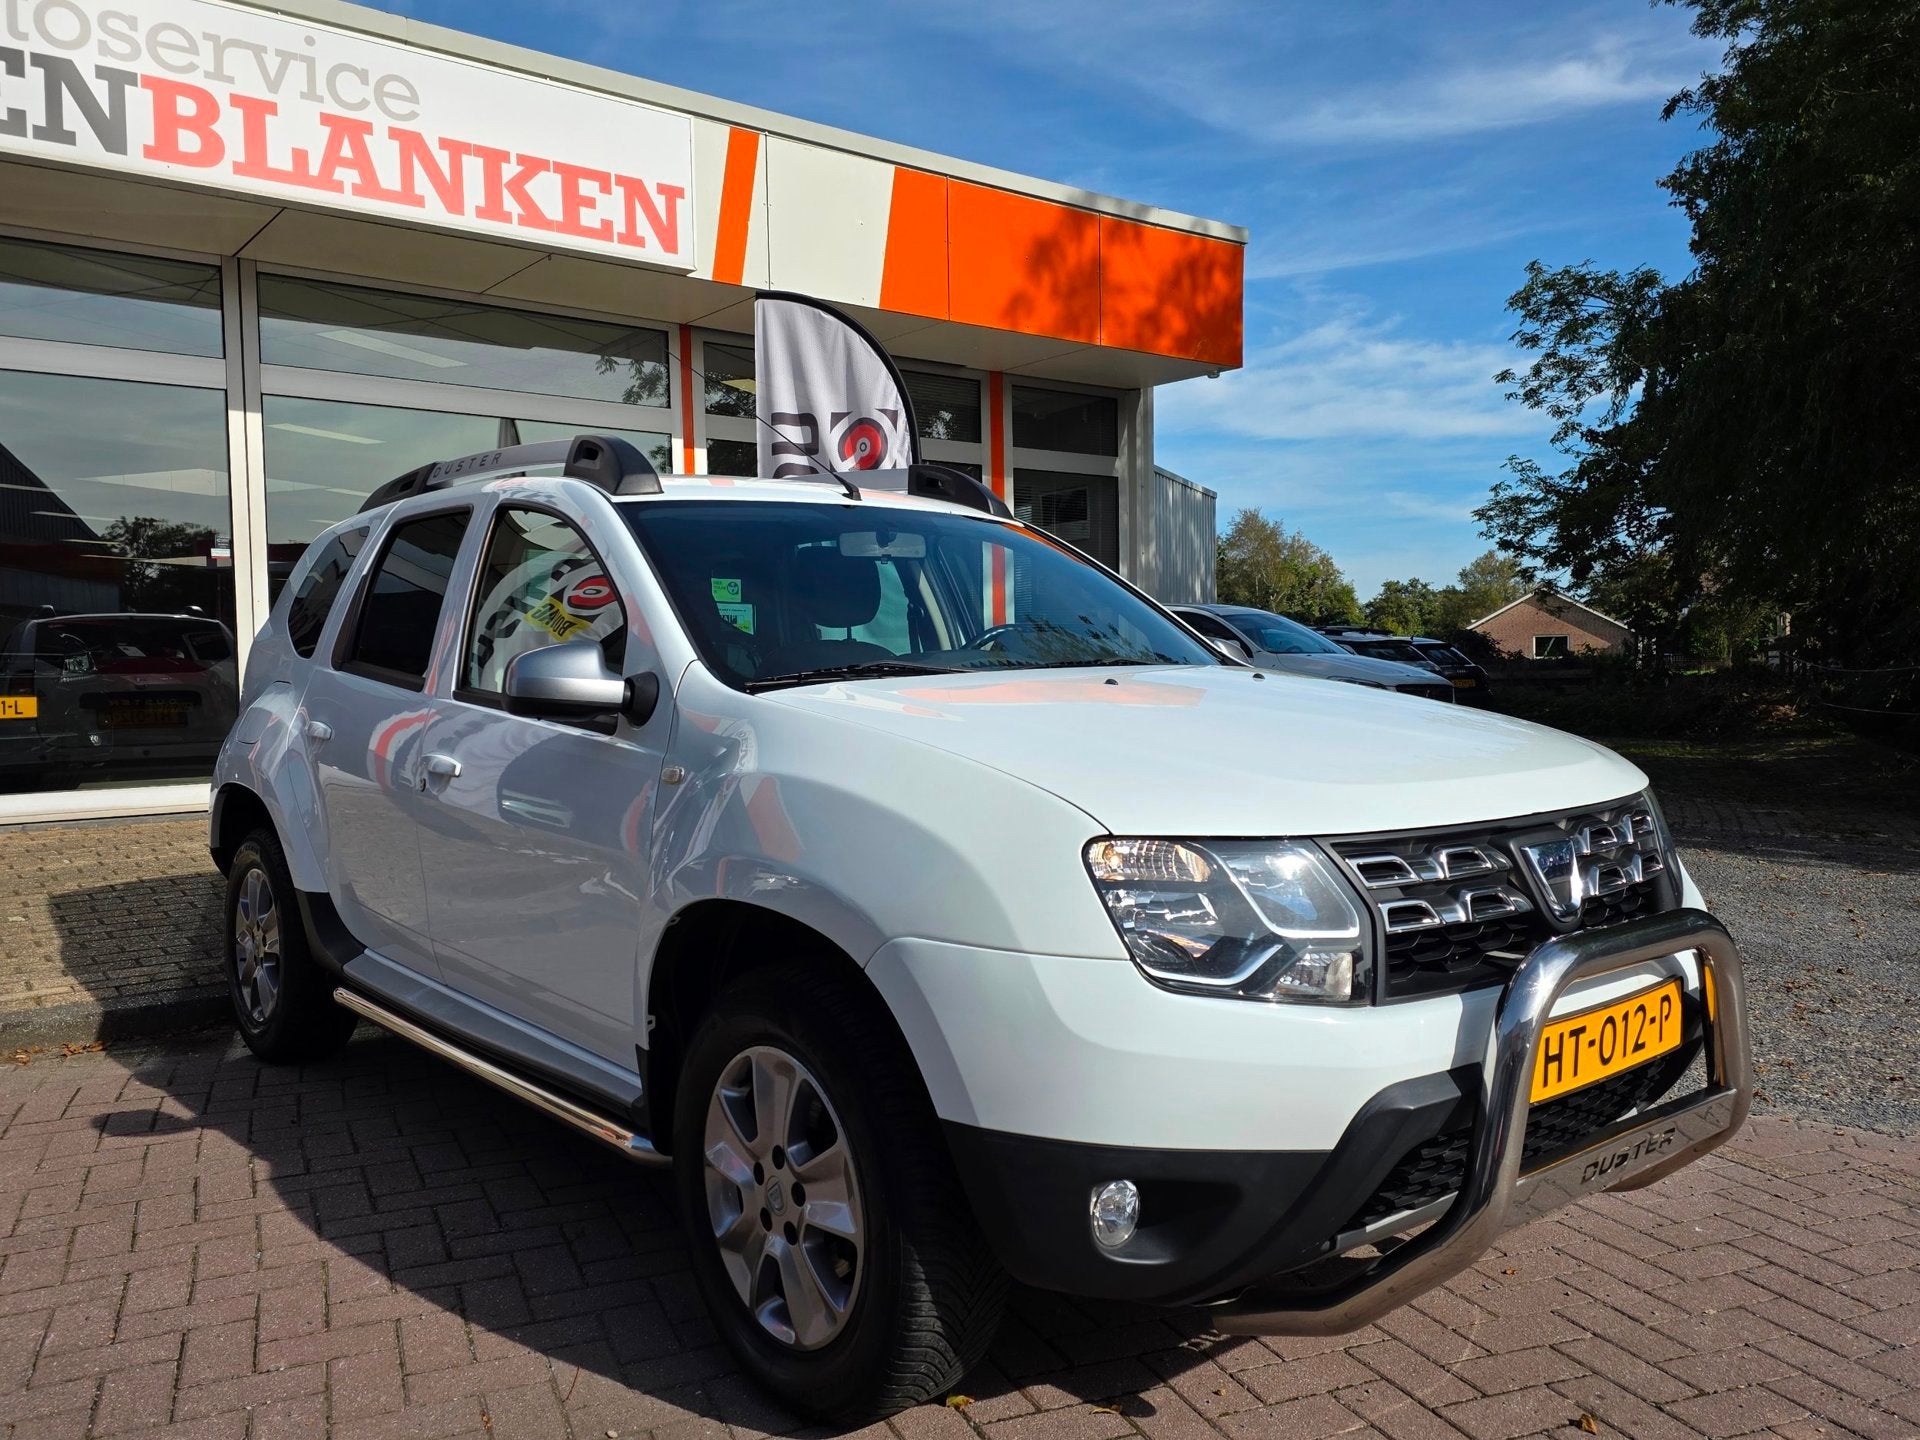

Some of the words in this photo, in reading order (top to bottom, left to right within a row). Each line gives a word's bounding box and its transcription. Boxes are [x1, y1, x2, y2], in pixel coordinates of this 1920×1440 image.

[432, 452, 502, 478] DUSTER
[1543, 993, 1672, 1088] HT-012-P
[1580, 1127, 1676, 1185] DUSTER
